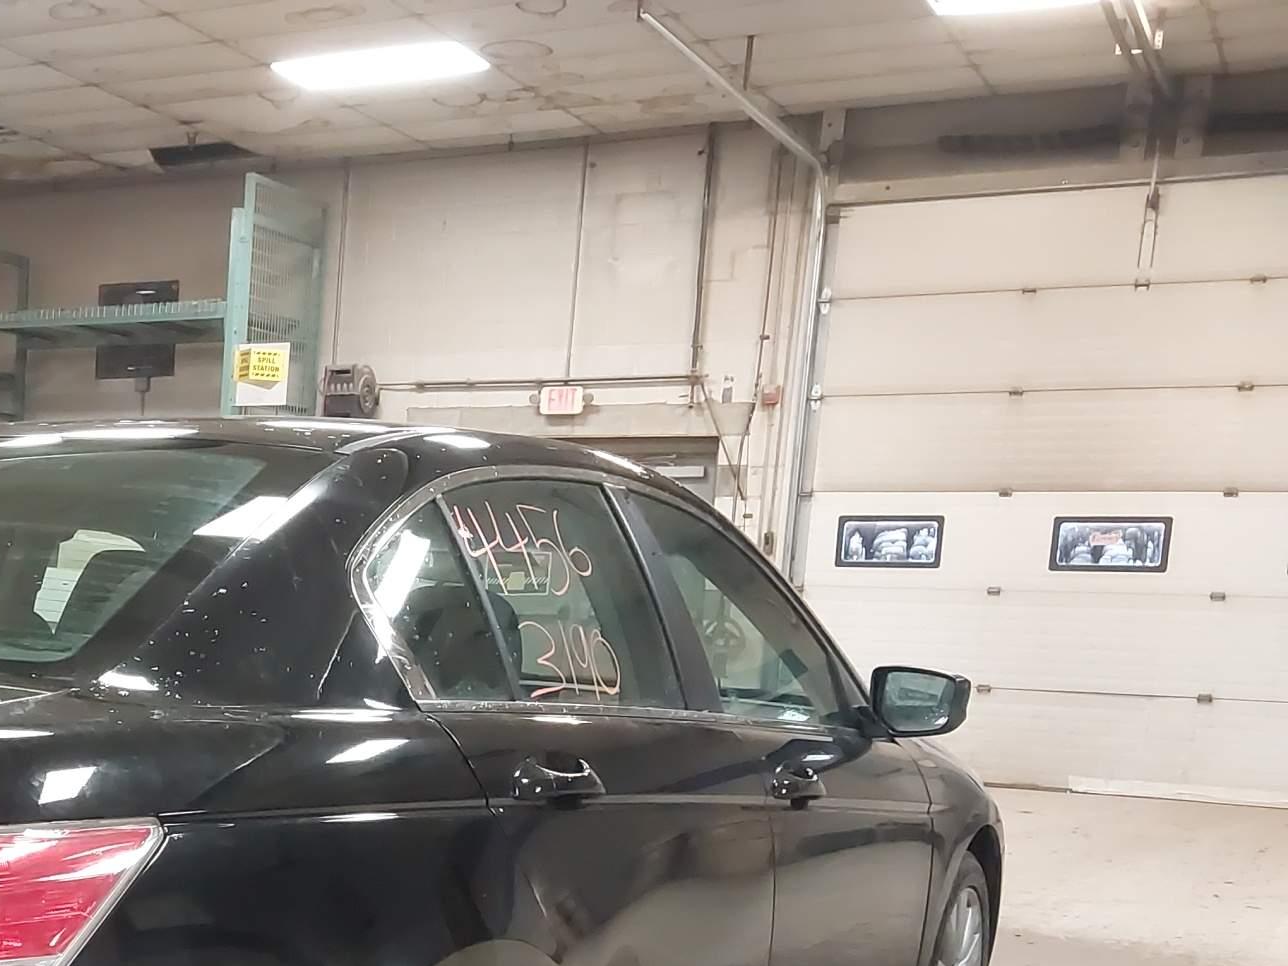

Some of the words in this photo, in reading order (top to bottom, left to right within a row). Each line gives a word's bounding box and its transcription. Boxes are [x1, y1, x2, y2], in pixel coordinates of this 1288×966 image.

[548, 388, 577, 411] EXIT
[454, 501, 592, 595] 4456
[517, 620, 621, 701] 3190
